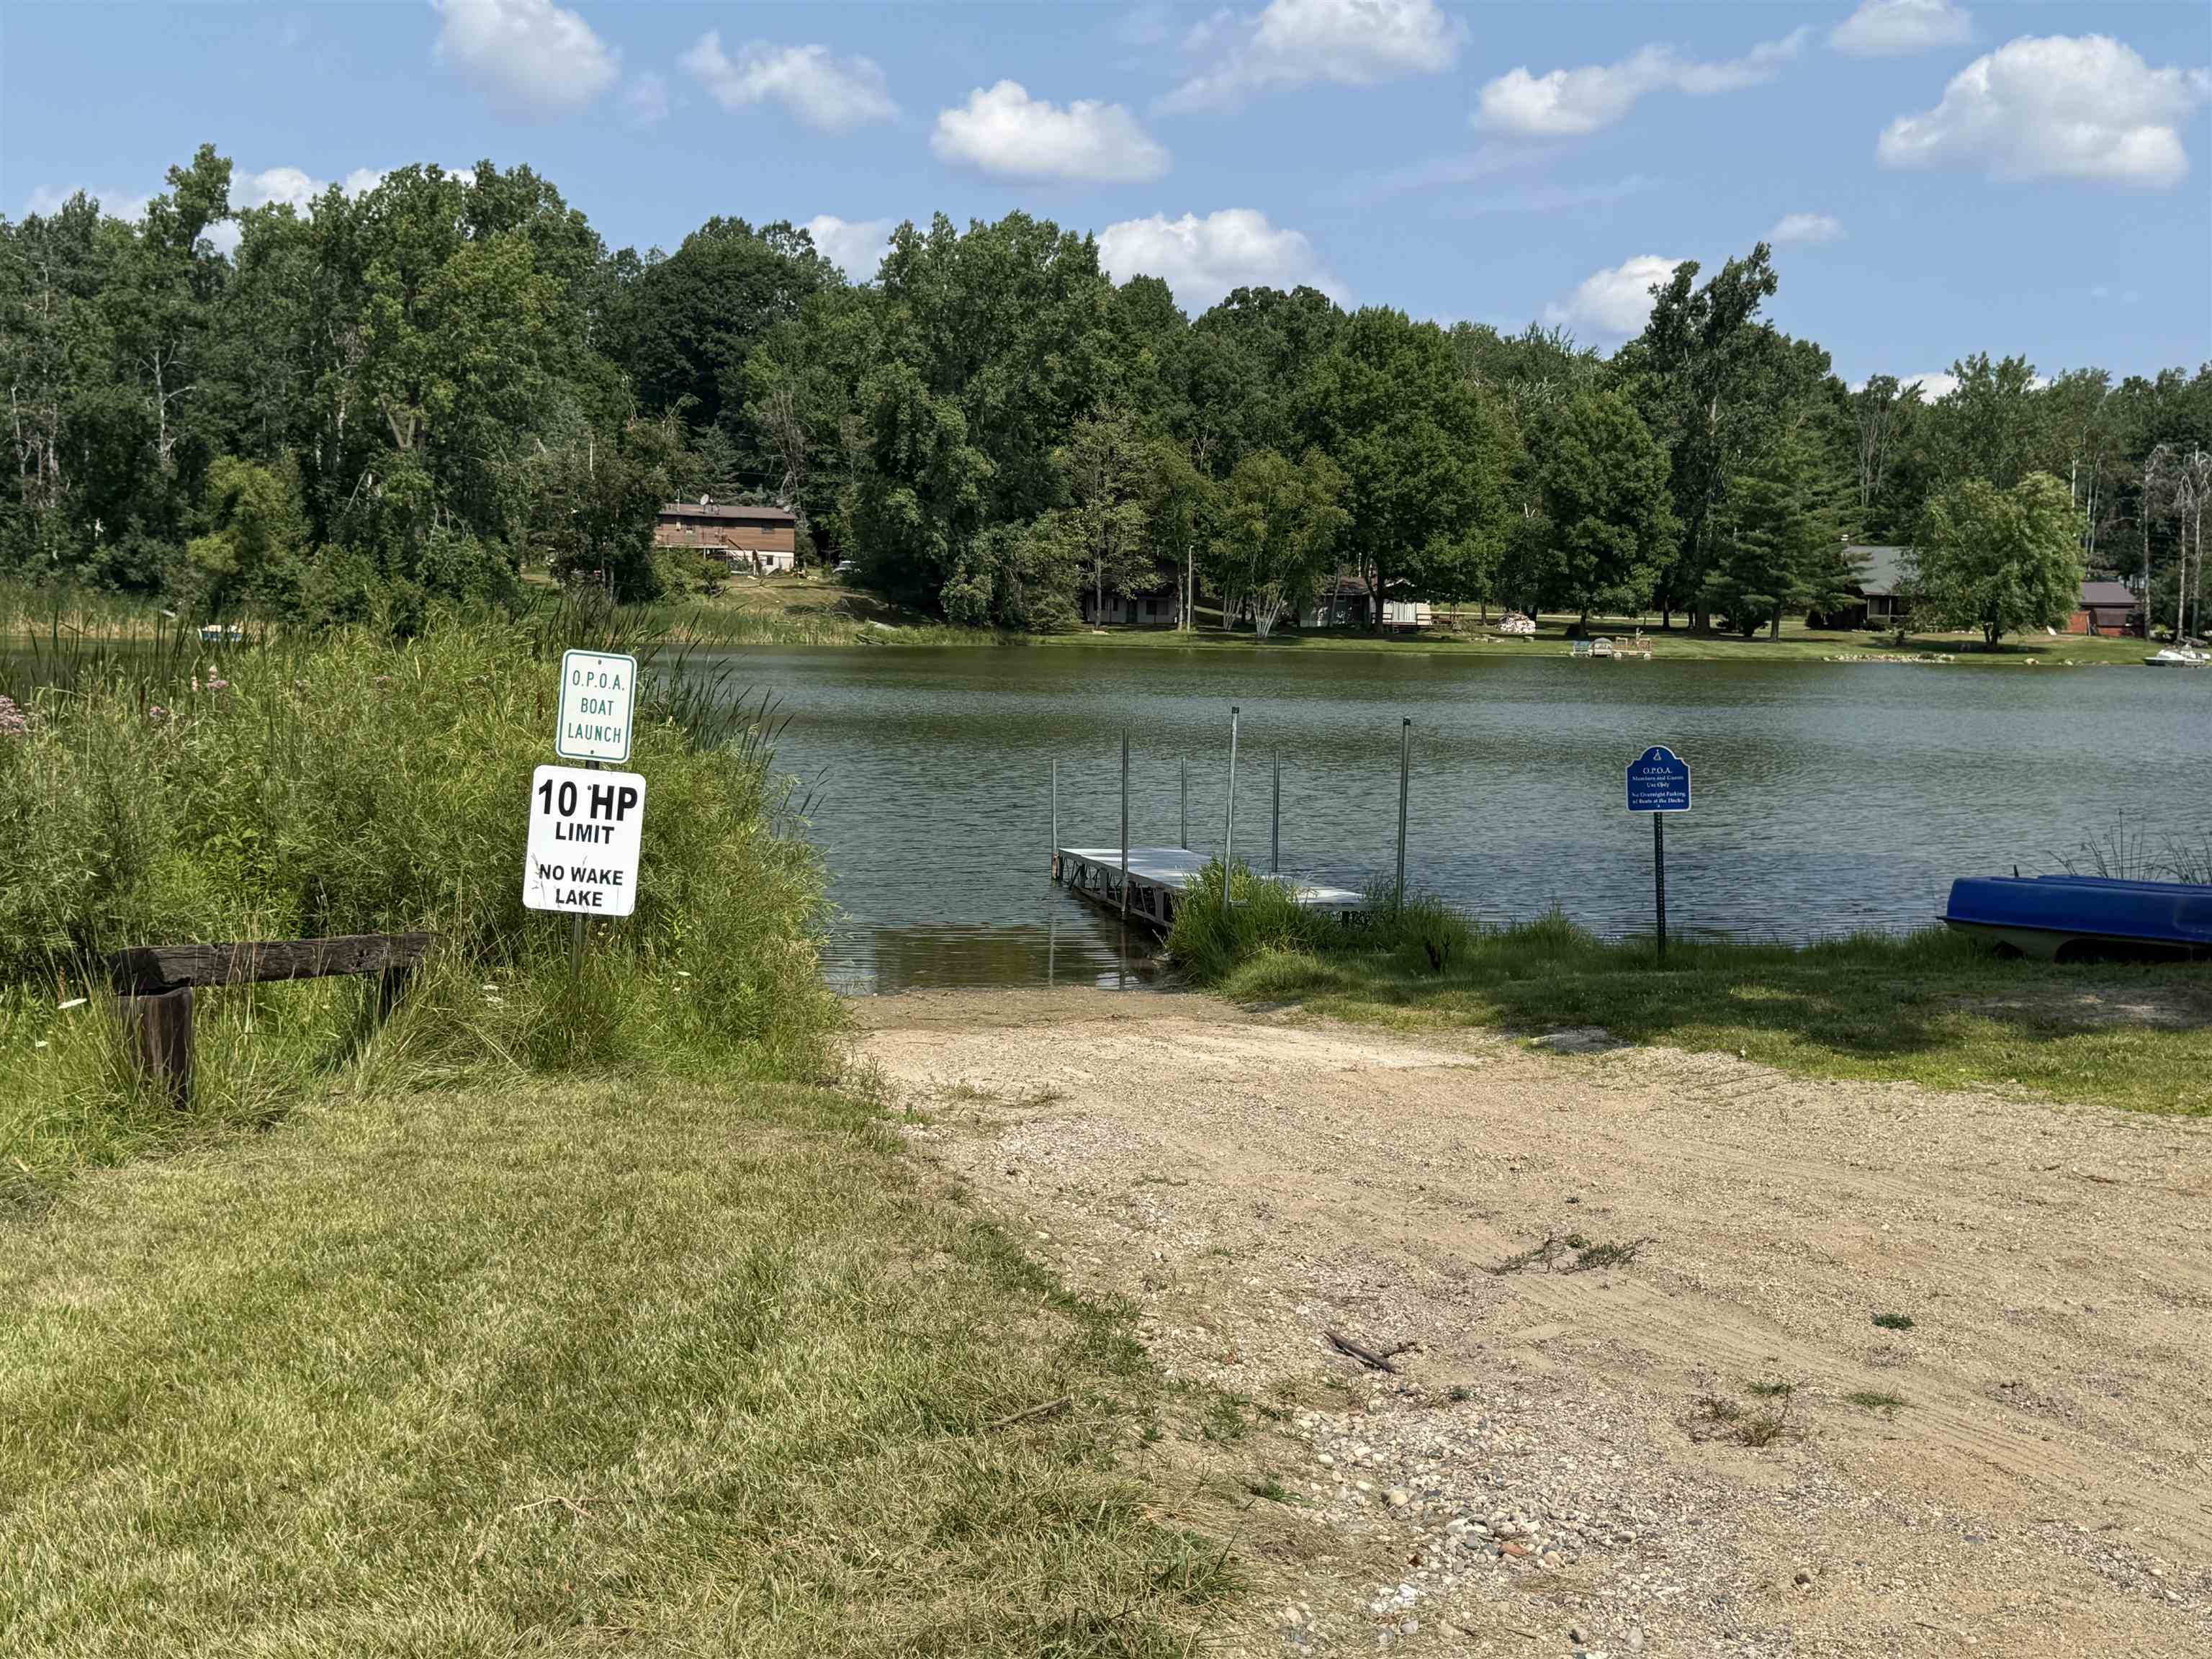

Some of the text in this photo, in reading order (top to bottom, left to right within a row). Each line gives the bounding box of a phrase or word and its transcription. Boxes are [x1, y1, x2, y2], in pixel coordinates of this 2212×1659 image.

[572, 670, 625, 691] O.P.O.A.
[580, 697, 614, 716] BOAT
[568, 722, 621, 743] LAUNCH
[538, 779, 638, 821] 10 HP
[555, 822, 614, 845] LIMIT
[539, 864, 624, 886] NO WAKE
[555, 888, 603, 907] LAKE
